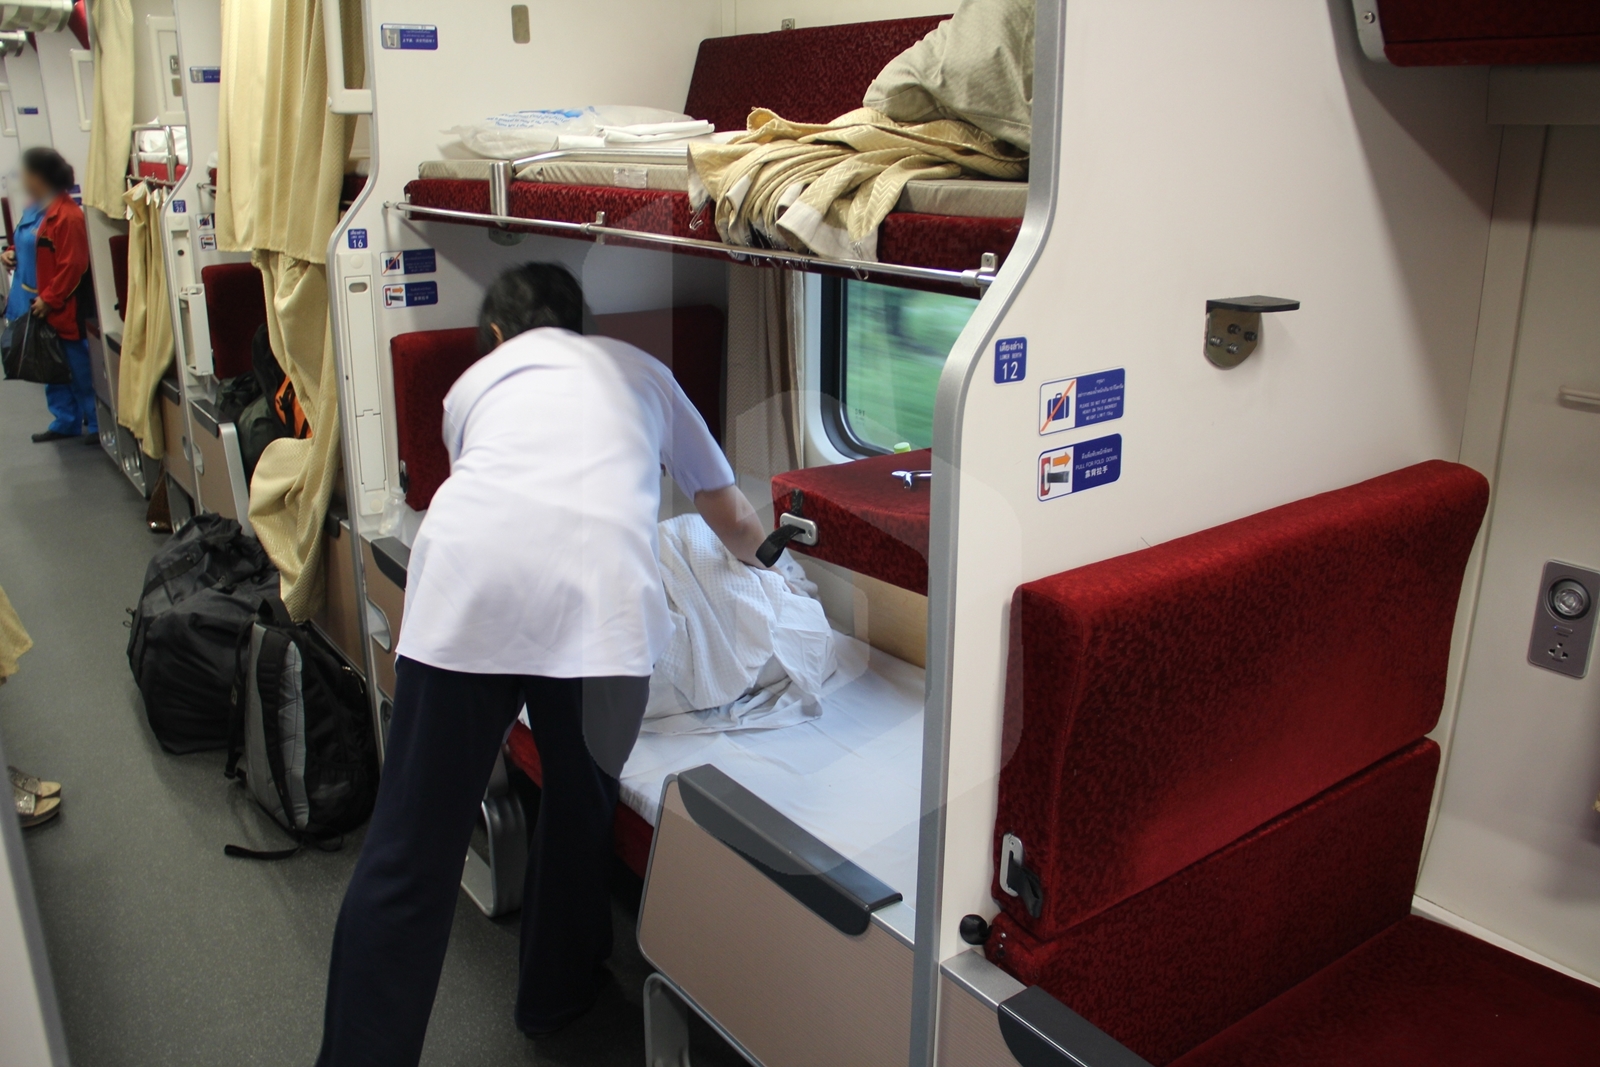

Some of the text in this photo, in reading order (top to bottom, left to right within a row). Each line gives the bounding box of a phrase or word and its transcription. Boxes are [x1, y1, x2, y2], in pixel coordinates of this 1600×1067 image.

[352, 239, 364, 248] 16
[999, 341, 1024, 352] เตียงล่าง
[1002, 361, 1018, 380] 12
[1094, 458, 1104, 466] FOLD
[1106, 454, 1118, 462] DOWN
